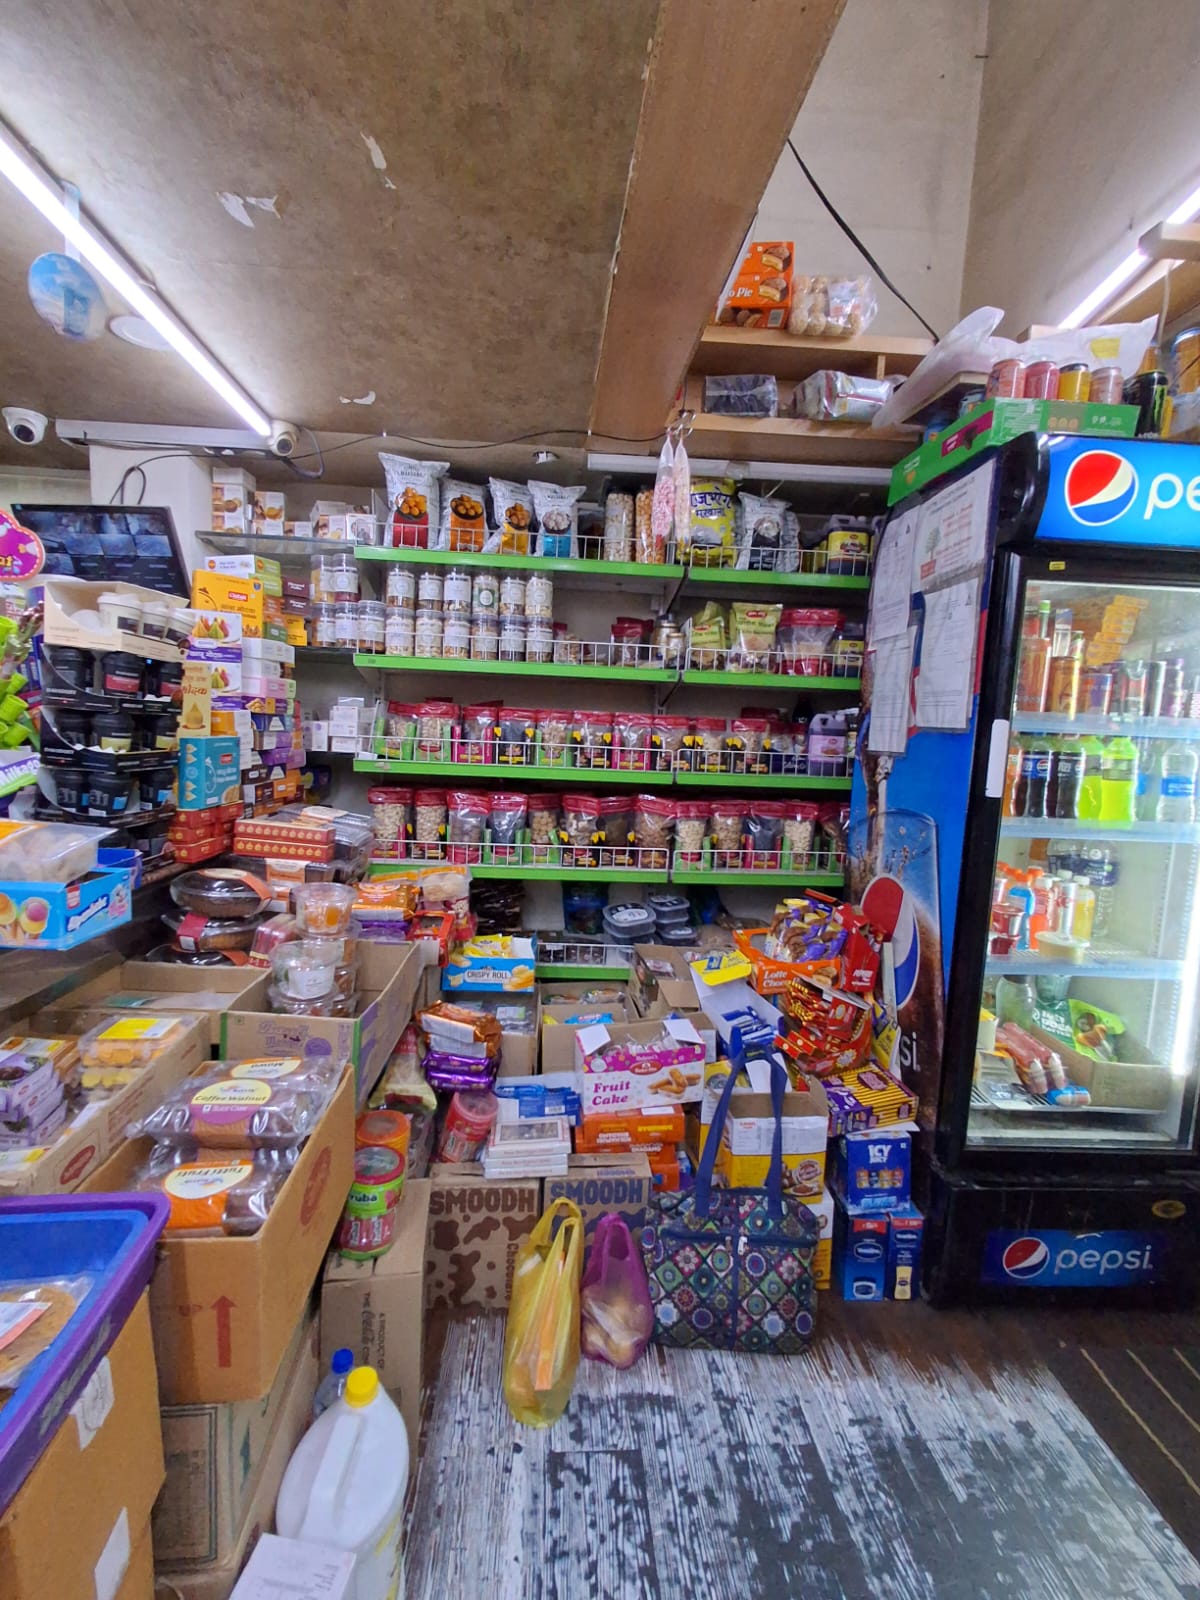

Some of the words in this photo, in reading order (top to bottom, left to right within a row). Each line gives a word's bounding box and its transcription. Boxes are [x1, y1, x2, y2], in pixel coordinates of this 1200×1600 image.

[492, 971, 508, 979] ROLL
[593, 1080, 631, 1093] Fruit
[194, 1094, 228, 1102] Coffee
[591, 1093, 629, 1106] Cake
[429, 1188, 535, 1215] SMOODH
[550, 1178, 644, 1205] SMOODH
[1054, 1245, 1152, 1275] pepsi
[378, 1319, 386, 1357] PRODUCT
